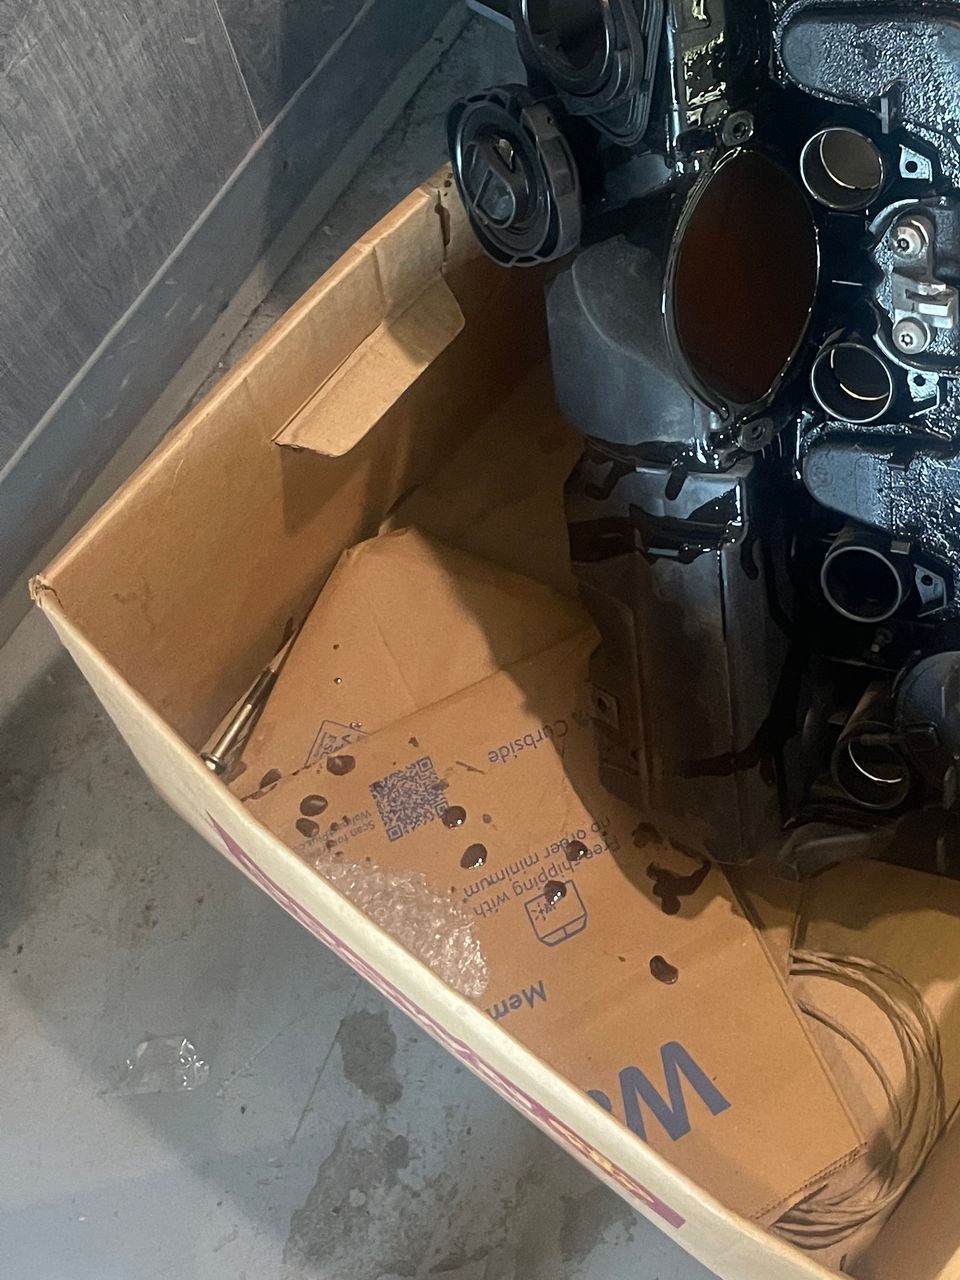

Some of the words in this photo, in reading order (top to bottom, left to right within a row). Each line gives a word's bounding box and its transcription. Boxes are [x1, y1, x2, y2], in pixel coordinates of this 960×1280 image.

[488, 720, 570, 766] Curbside
[351, 820, 376, 837] Scan
[591, 816, 610, 832] no
[512, 852, 581, 896] hipping
[473, 891, 510, 918] with
[586, 1040, 732, 1142] W
